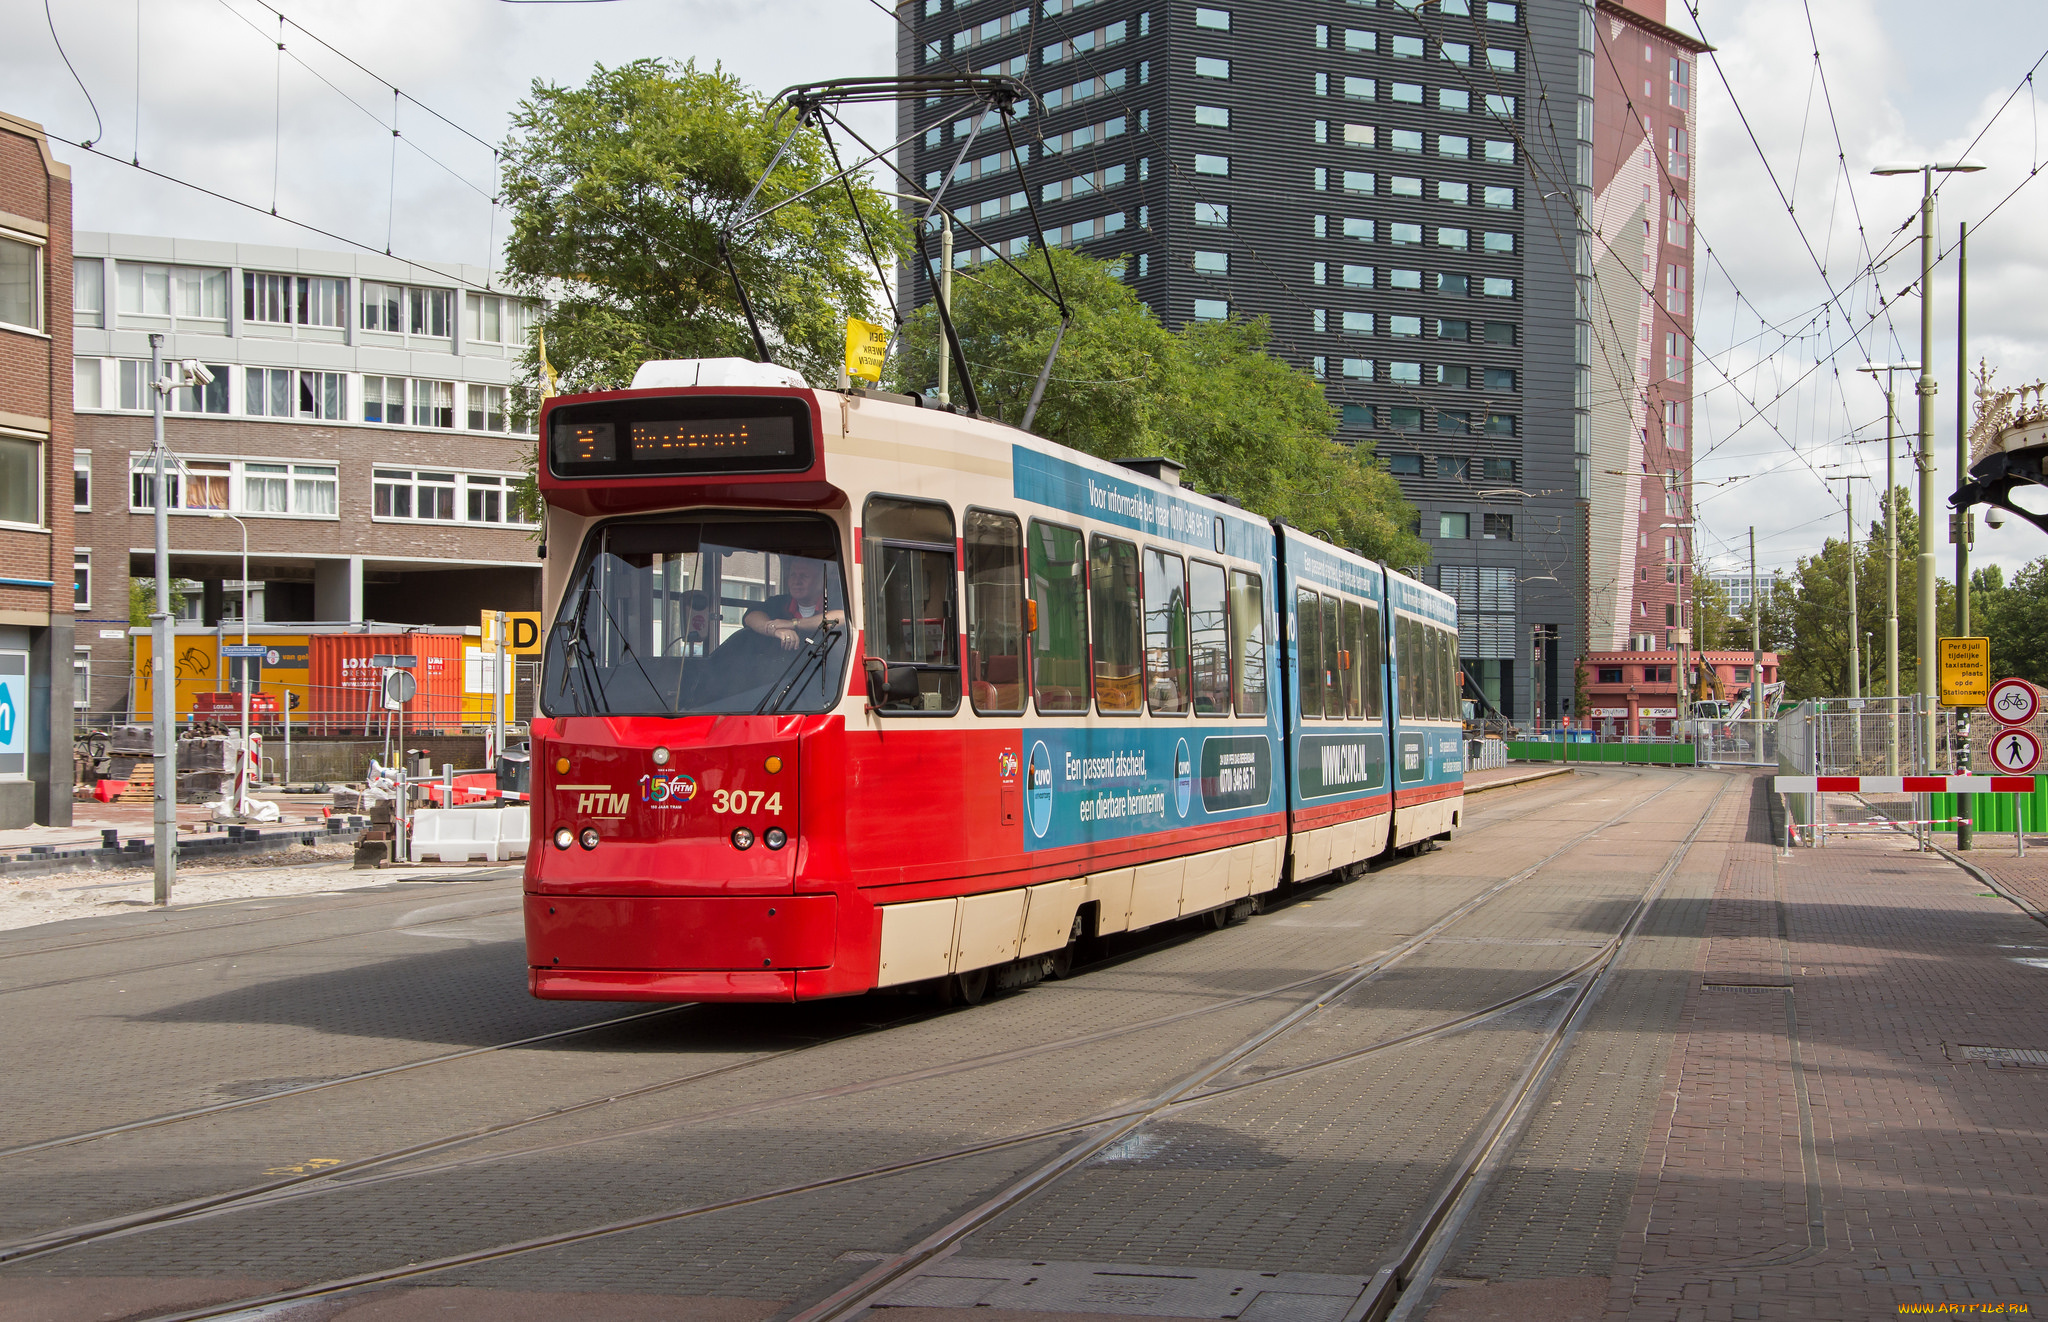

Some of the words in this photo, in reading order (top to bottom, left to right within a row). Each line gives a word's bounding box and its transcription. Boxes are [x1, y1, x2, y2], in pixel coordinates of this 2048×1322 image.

[1088, 478, 1106, 509] Voor
[1108, 484, 1143, 520] informatie
[1144, 496, 1154, 523] bel
[1155, 504, 1169, 527] naar
[1185, 508, 1195, 535] 346
[513, 618, 538, 648] D
[342, 658, 382, 668] LOXA
[1035, 769, 1050, 785] CUVO
[1066, 752, 1081, 780] Een
[1082, 750, 1114, 786] passend
[1116, 749, 1147, 780] afscheid,
[1321, 744, 1367, 786] WWW.CUVO.NL
[577, 793, 630, 814] HTM
[712, 790, 782, 815] 3074
[1080, 798, 1094, 822] een
[1096, 791, 1126, 820] dierbare
[1127, 788, 1164, 818] herinnering
